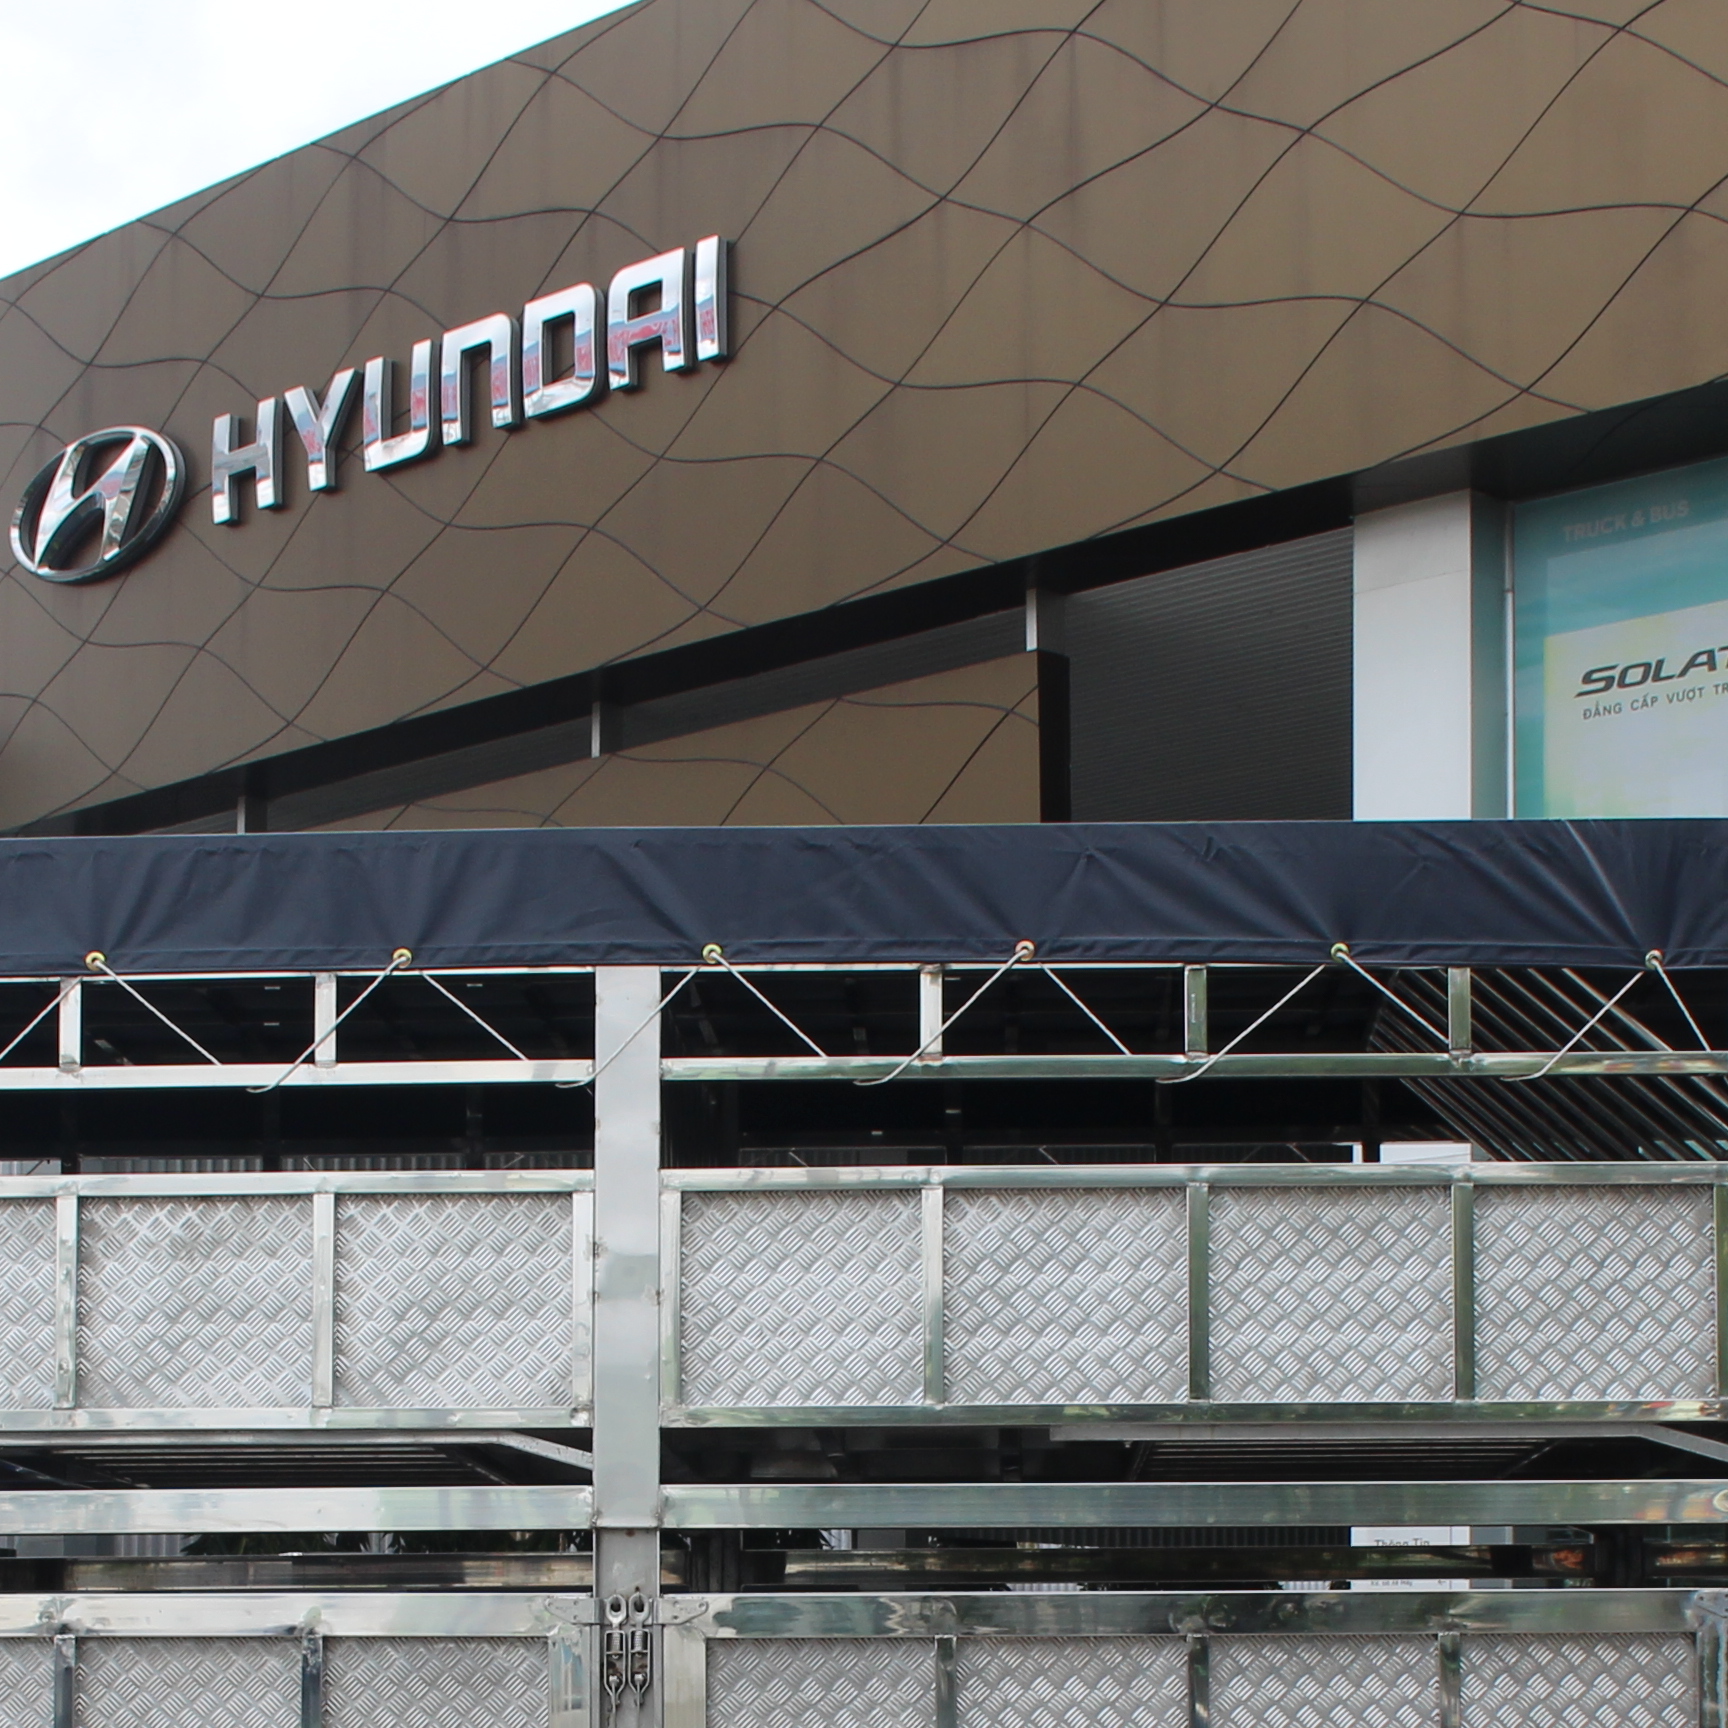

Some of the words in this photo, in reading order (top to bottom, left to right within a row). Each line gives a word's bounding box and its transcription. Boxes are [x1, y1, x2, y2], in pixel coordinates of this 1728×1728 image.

[211, 235, 729, 526] HYUNDAI
[1562, 512, 1627, 543] TRUCK
[1631, 509, 1646, 527] &
[1650, 499, 1690, 523] BUS
